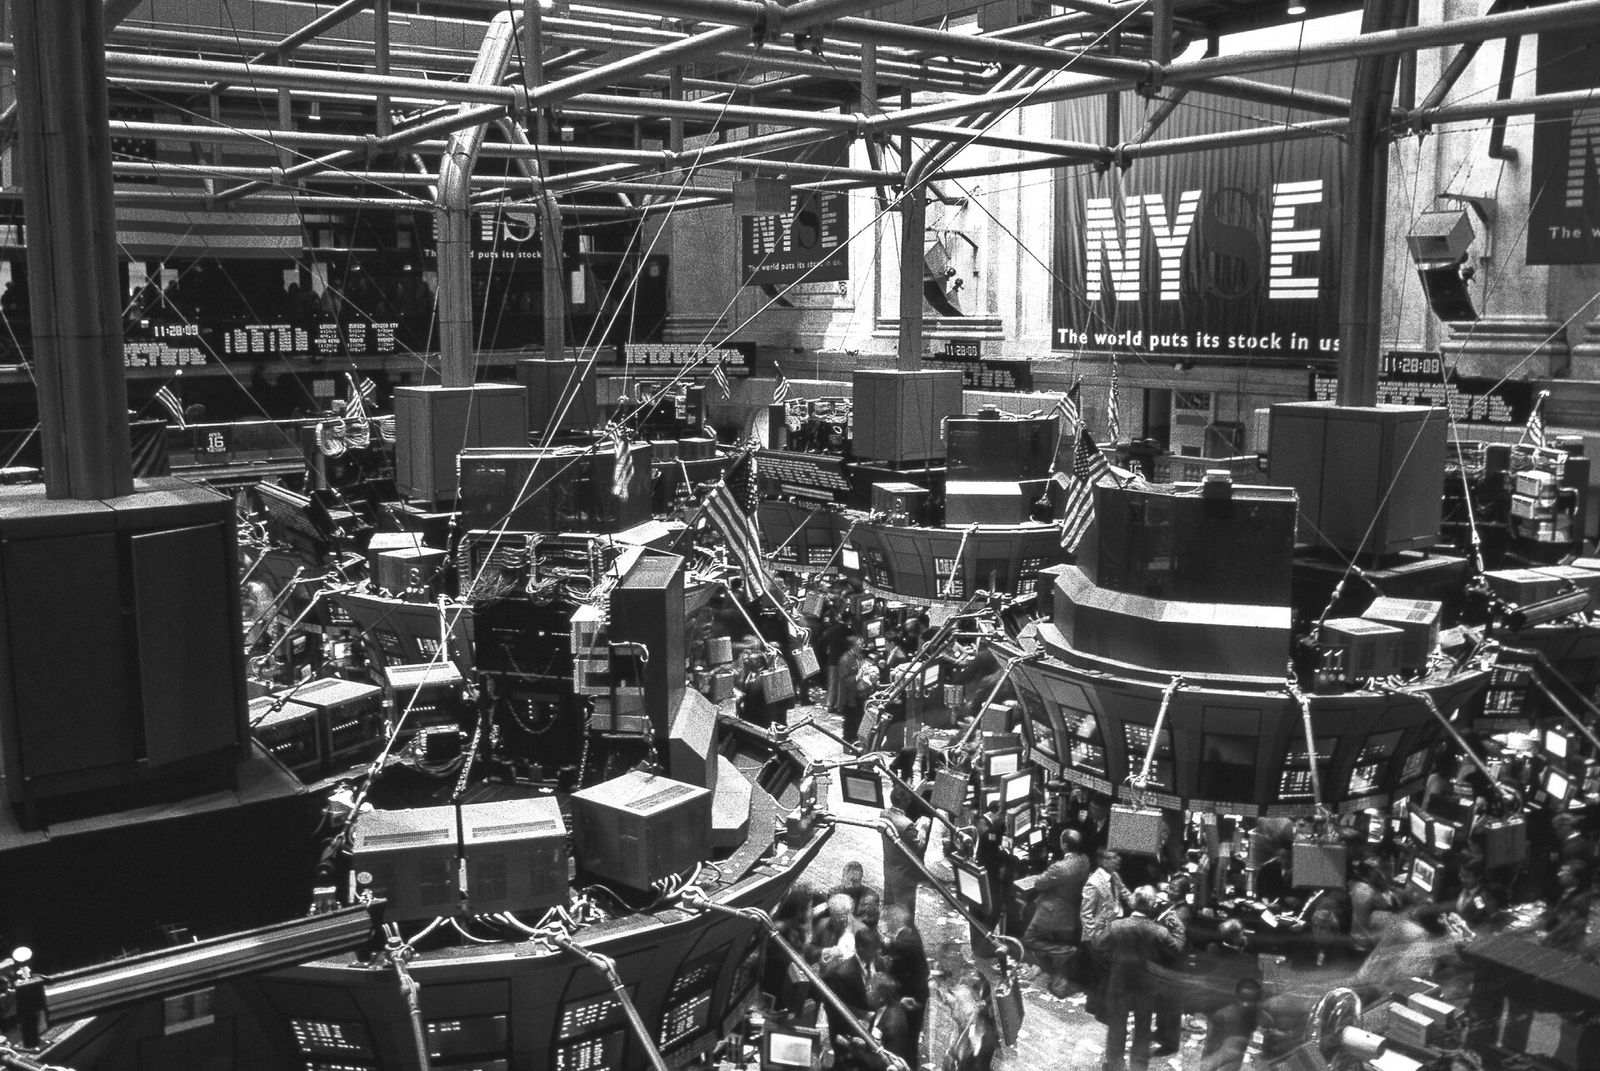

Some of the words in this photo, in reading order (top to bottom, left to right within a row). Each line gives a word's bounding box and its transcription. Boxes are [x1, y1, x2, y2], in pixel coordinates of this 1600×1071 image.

[1548, 226, 1582, 239] The
[1086, 179, 1323, 301] NYSE
[478, 252, 499, 260] puts
[761, 263, 780, 271] world
[781, 263, 795, 271] puts
[1057, 327, 1088, 345] The
[1093, 329, 1143, 347] world
[1149, 332, 1189, 352] puts
[1196, 331, 1220, 348] its
[1228, 332, 1282, 350] stock
[1291, 332, 1309, 350] in
[208, 436, 224, 448] 16
